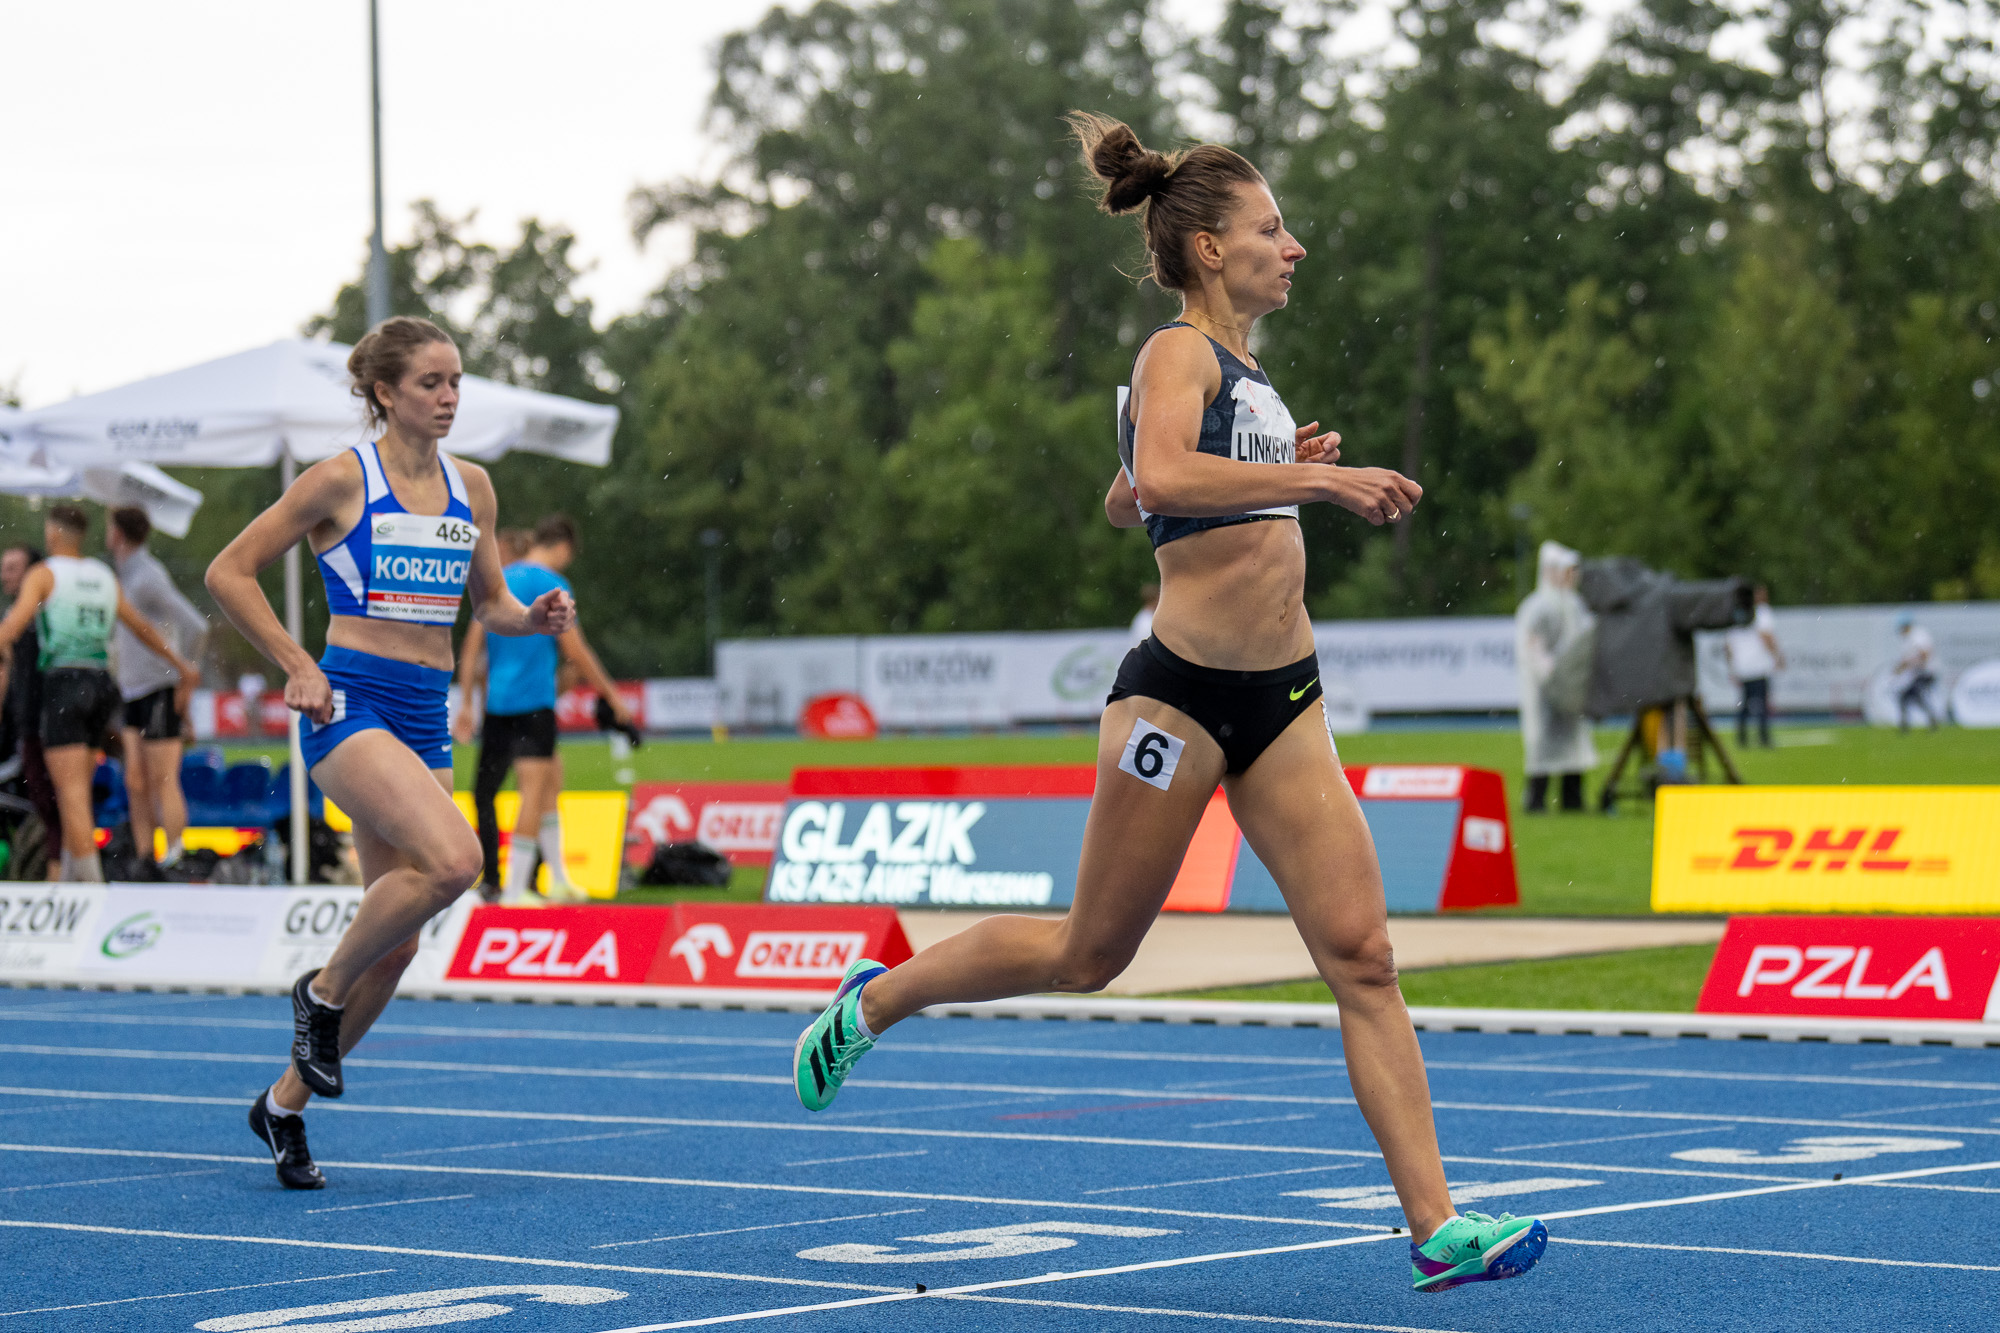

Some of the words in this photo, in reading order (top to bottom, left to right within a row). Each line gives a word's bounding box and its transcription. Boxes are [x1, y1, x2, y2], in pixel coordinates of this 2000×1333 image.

[435, 522, 473, 544] 465
[375, 555, 471, 585] KORZUCH
[1134, 732, 1169, 778] 6
[706, 808, 777, 840] ORLE
[781, 801, 987, 865] GLAZIK
[1729, 828, 1912, 871] DHL
[769, 860, 814, 902] KS
[806, 862, 870, 903] AZS
[469, 928, 620, 979] PZLA
[749, 941, 854, 968] ORLEN
[1736, 945, 1953, 1001] PZLA
[795, 1221, 1183, 1264] 5
